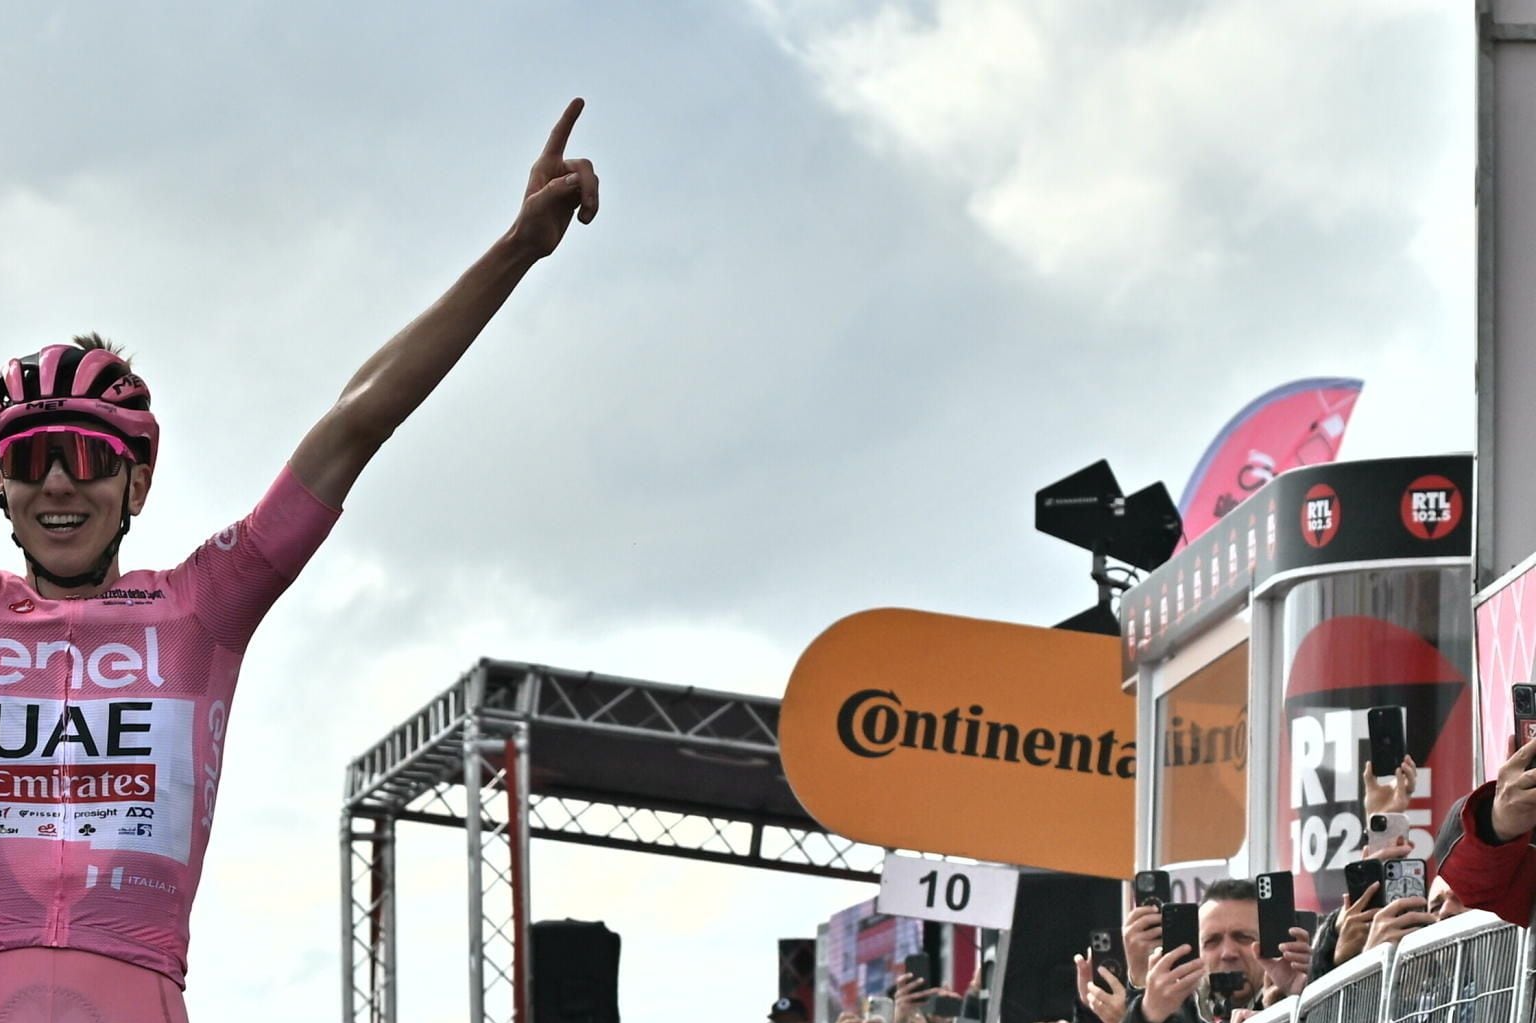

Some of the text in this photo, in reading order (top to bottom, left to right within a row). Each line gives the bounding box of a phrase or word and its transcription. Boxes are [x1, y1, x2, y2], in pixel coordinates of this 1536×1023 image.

[1307, 499, 1333, 519] RTL
[1412, 491, 1451, 509] RTL
[1307, 518, 1333, 532] 102.5
[1412, 509, 1451, 522] 102.5
[836, 688, 1136, 780] Continenta
[919, 869, 971, 912] 10
